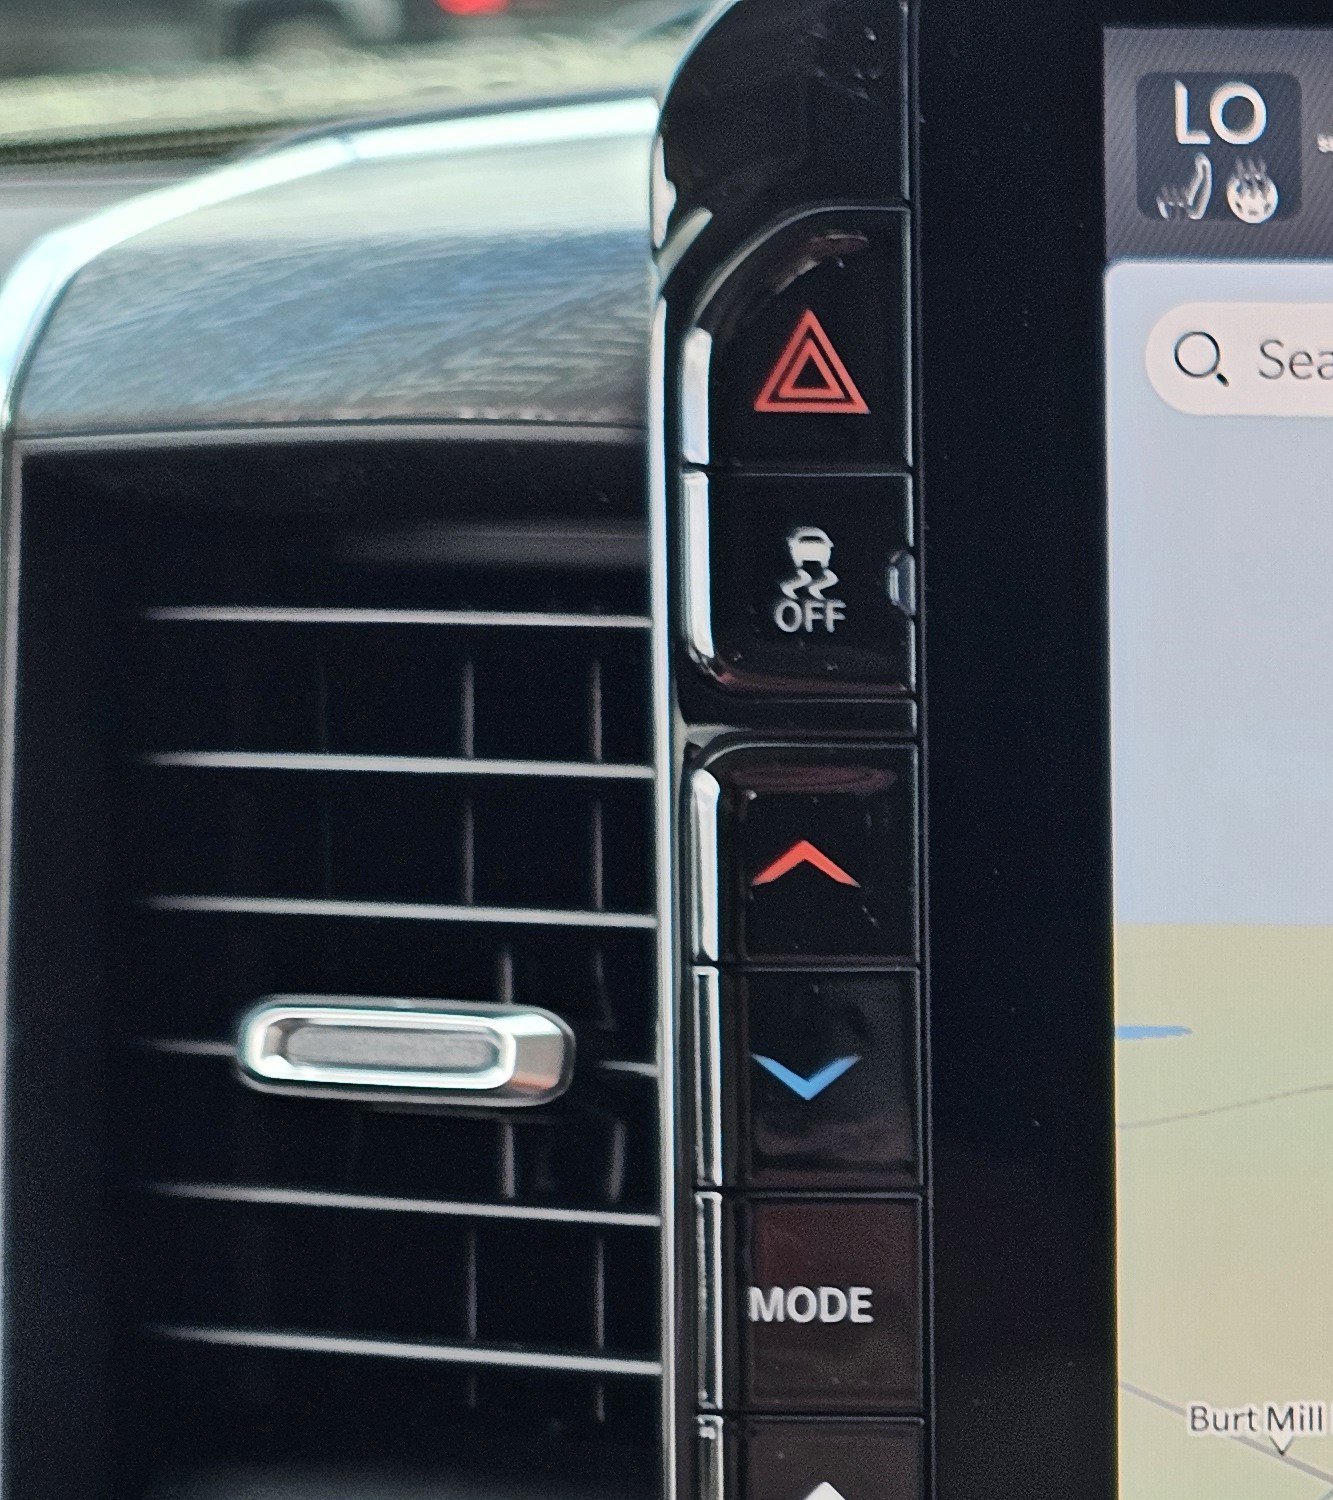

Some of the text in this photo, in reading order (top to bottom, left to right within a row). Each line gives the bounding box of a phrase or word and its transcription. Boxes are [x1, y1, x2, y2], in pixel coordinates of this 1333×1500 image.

[1174, 80, 1268, 146] LO
[773, 599, 847, 633] OFF
[748, 1286, 875, 1323] MODE
[1190, 1405, 1258, 1432] Burt
[1266, 1405, 1324, 1432] Mill
